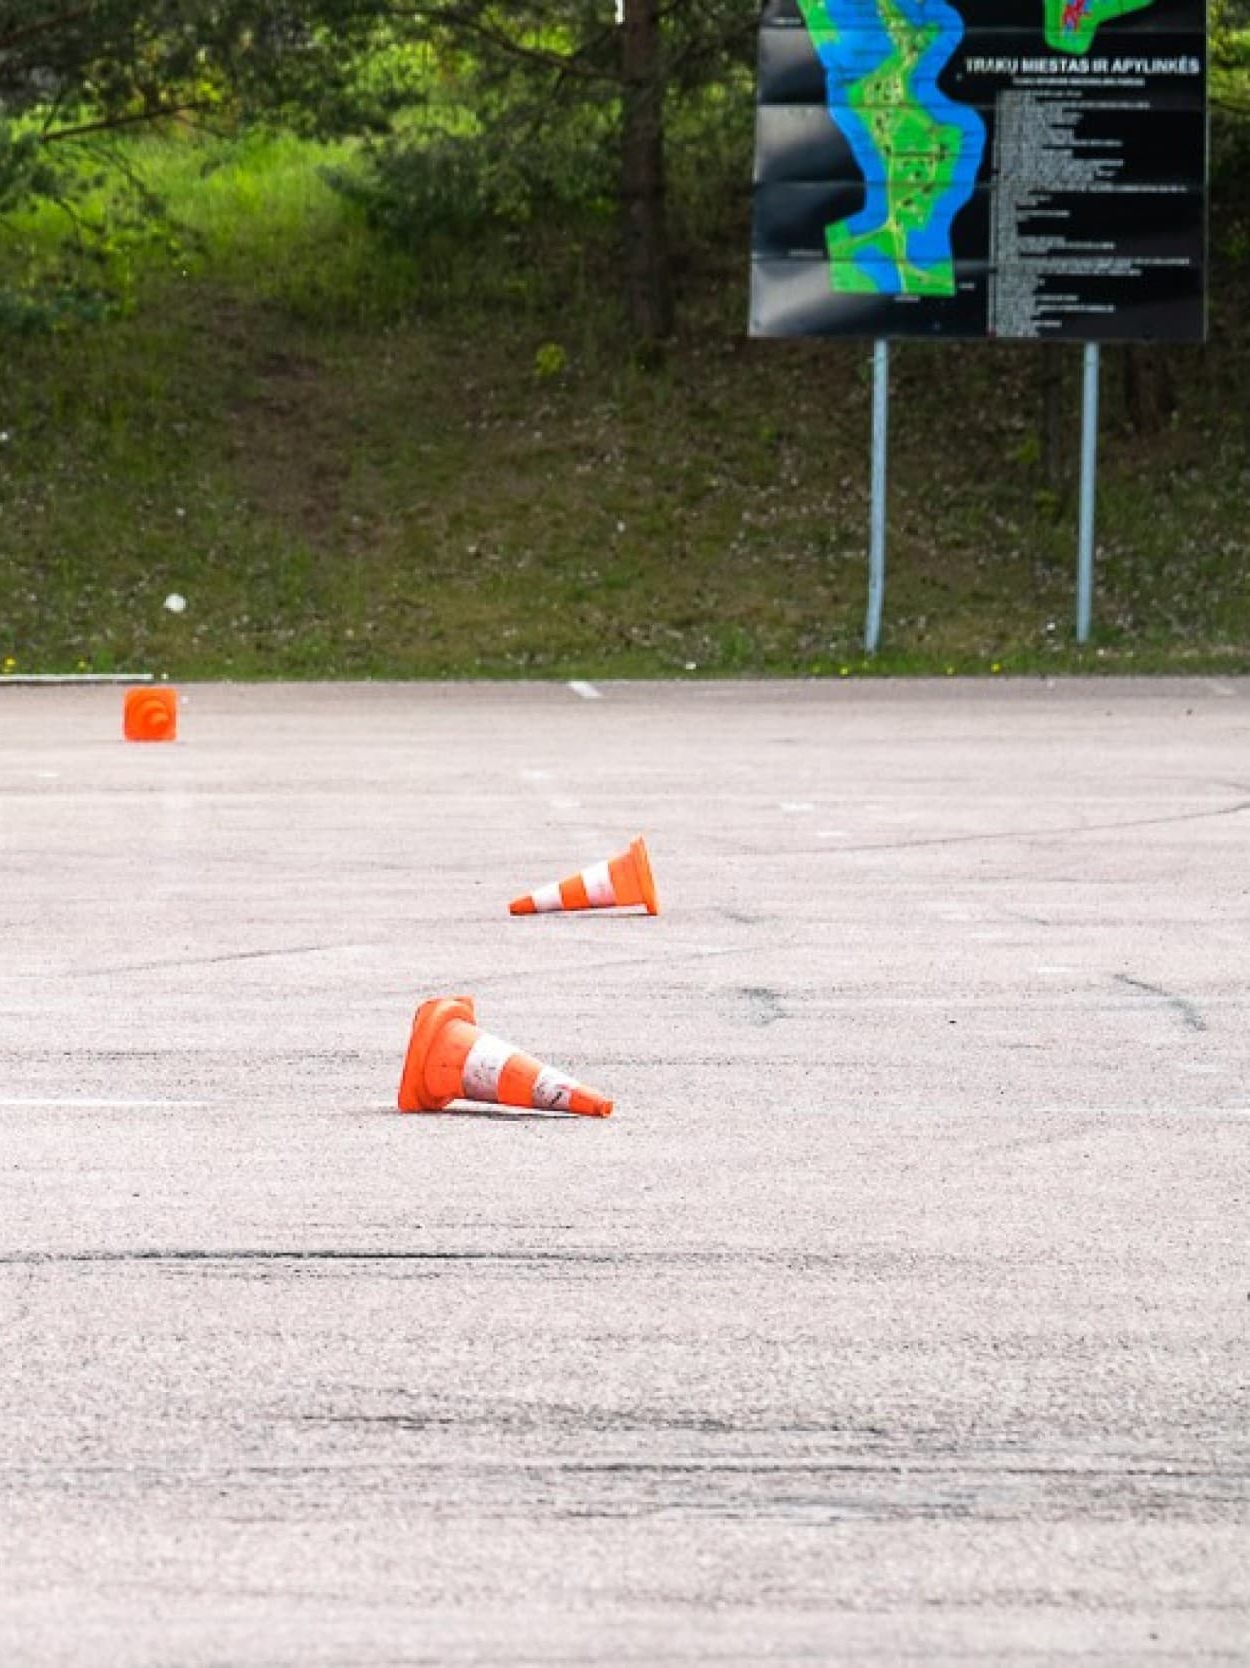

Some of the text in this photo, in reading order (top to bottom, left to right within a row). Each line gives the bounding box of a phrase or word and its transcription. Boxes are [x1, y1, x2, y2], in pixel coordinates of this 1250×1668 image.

[1022, 57, 1089, 73] MIESTAS
[1093, 58, 1108, 73] IR
[1111, 54, 1199, 73] APYLINKĖS
